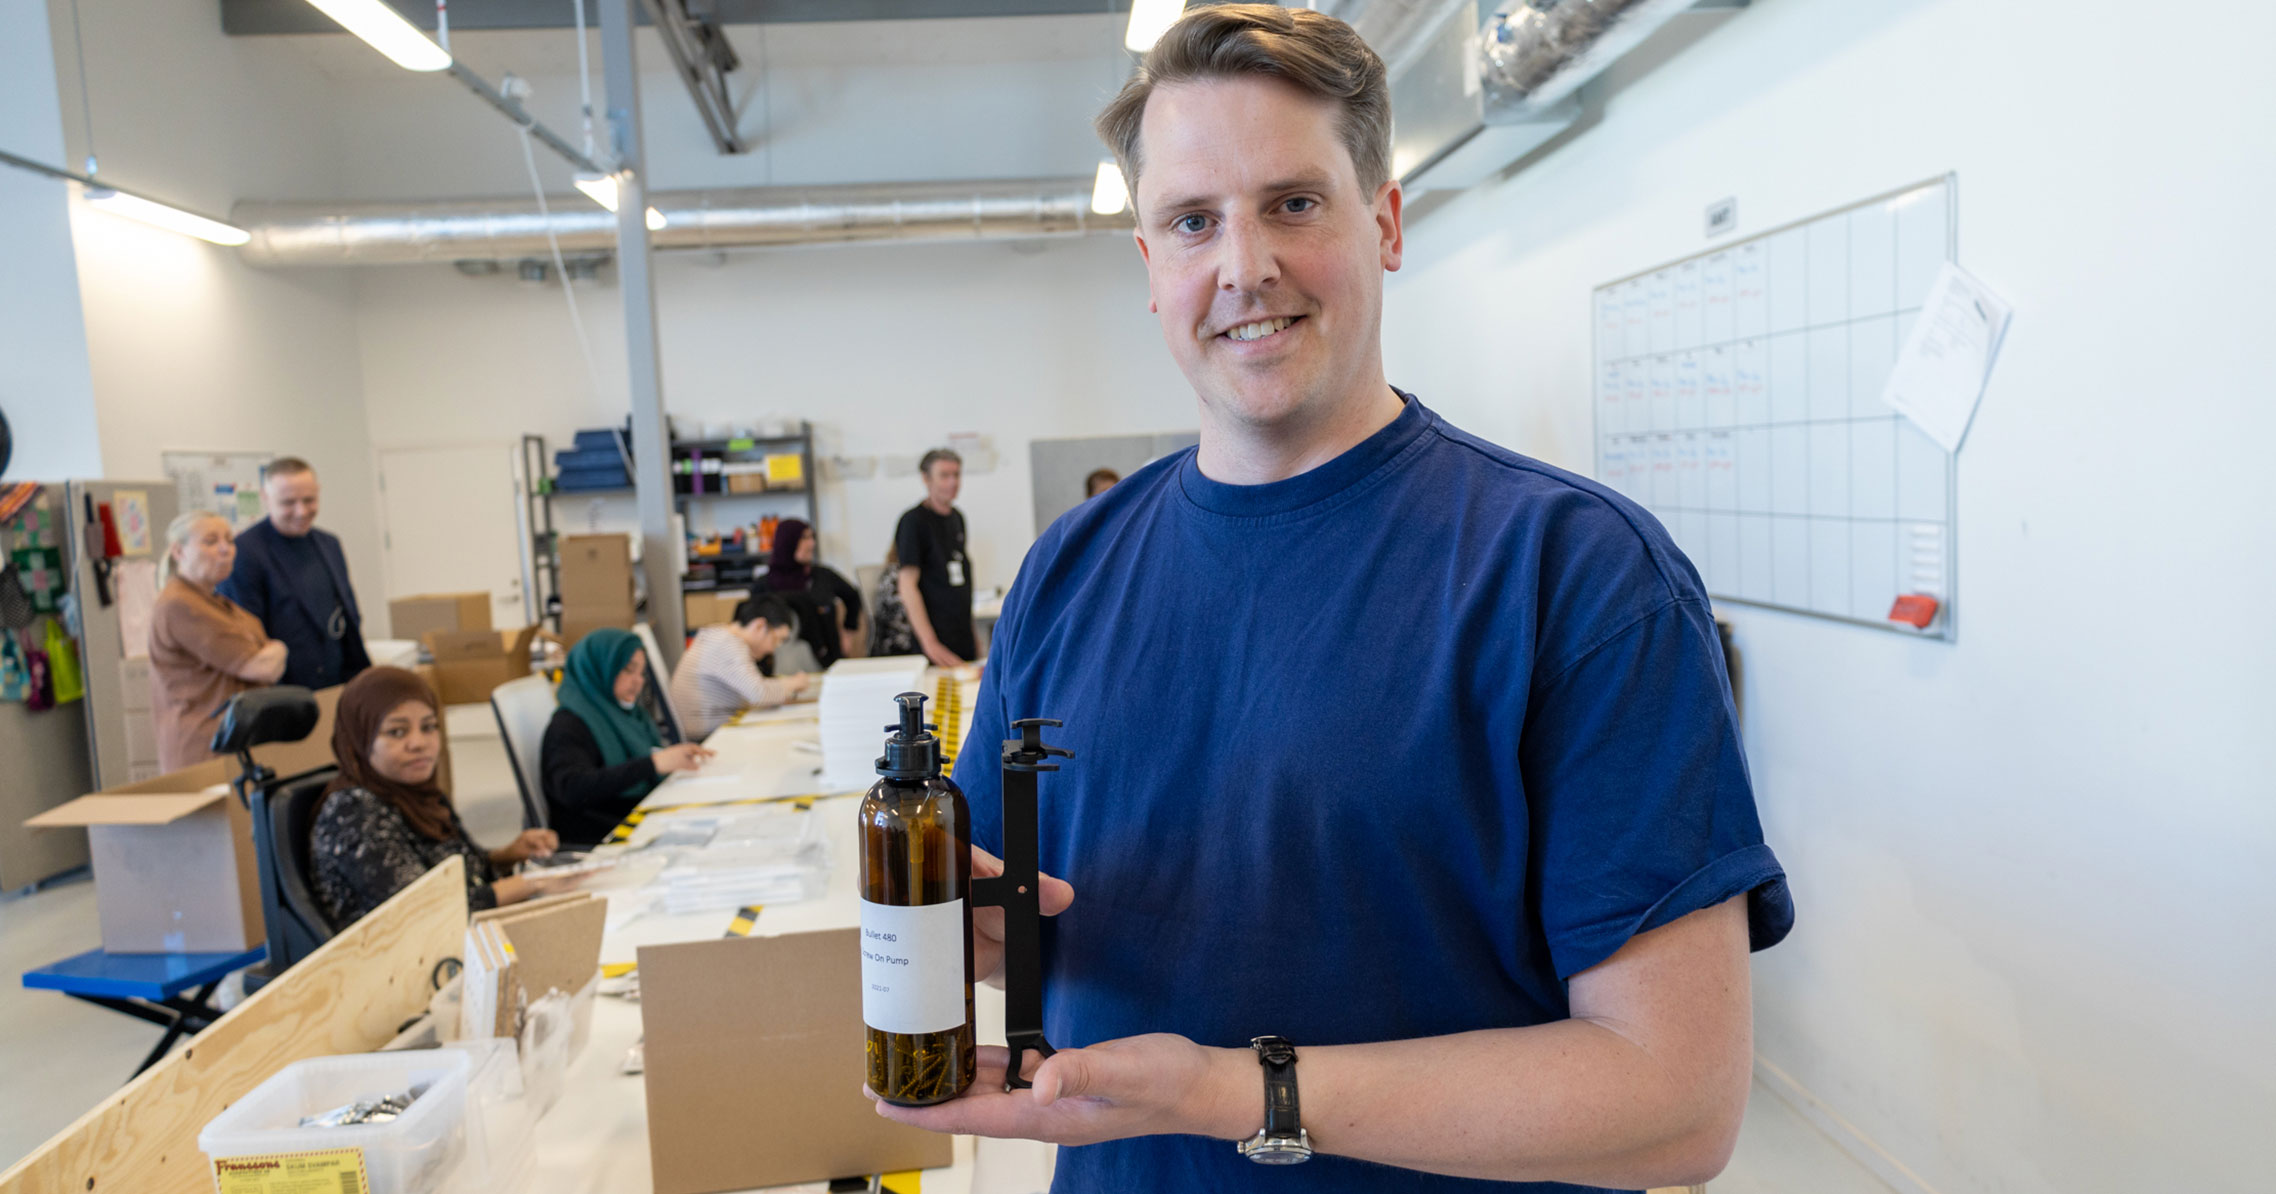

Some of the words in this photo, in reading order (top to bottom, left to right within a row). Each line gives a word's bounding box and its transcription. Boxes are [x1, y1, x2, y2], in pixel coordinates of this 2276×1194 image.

[865, 928, 881, 940] Bullet
[882, 933, 897, 942] 480
[875, 953, 884, 963] On
[886, 956, 909, 966] Pump
